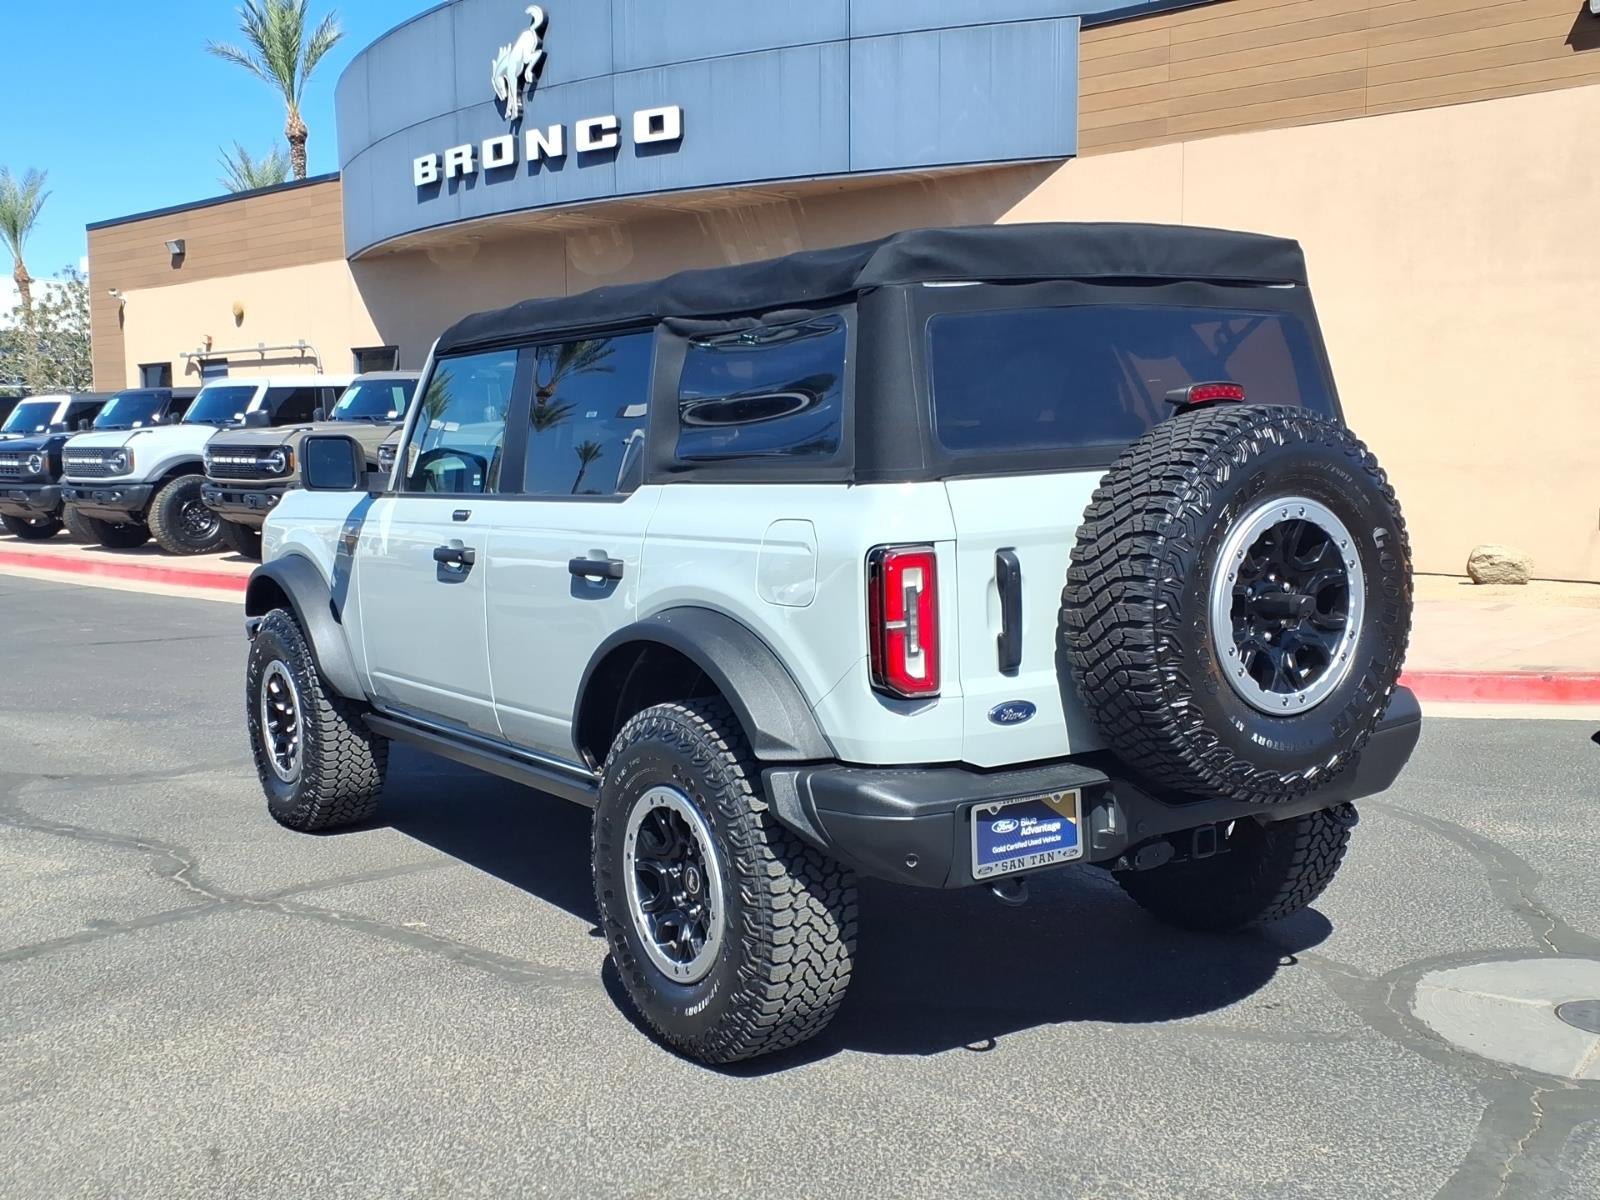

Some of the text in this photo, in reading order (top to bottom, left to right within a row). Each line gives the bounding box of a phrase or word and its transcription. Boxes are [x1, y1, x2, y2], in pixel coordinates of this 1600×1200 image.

[413, 105, 681, 187] BRONCO
[995, 820, 1016, 832] Ford
[1020, 816, 1037, 827] Blue
[1020, 822, 1061, 836] Advantage
[992, 835, 1061, 854] Gold Certified Used Vehicle
[1001, 851, 1055, 872] SAN TAN
